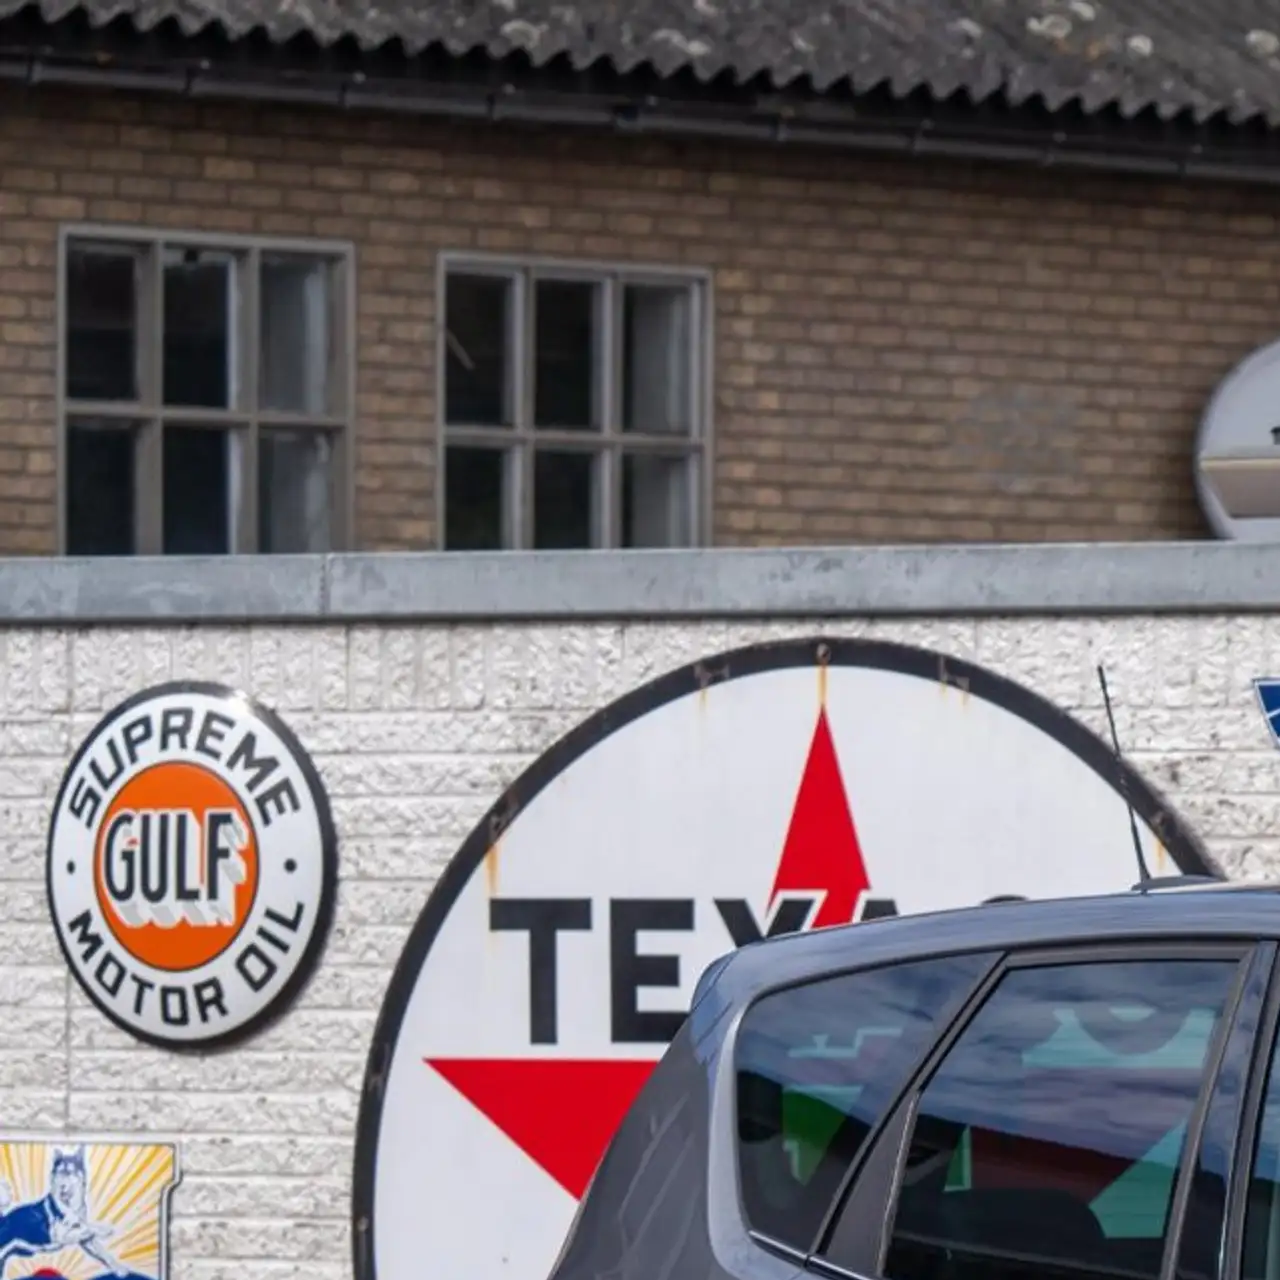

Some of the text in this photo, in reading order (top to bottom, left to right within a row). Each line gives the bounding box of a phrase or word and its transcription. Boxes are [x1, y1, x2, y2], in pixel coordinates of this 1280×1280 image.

[68, 707, 302, 829] SUPREME
[102, 809, 250, 928] GULF
[68, 902, 304, 1026] MOTOR OIL
